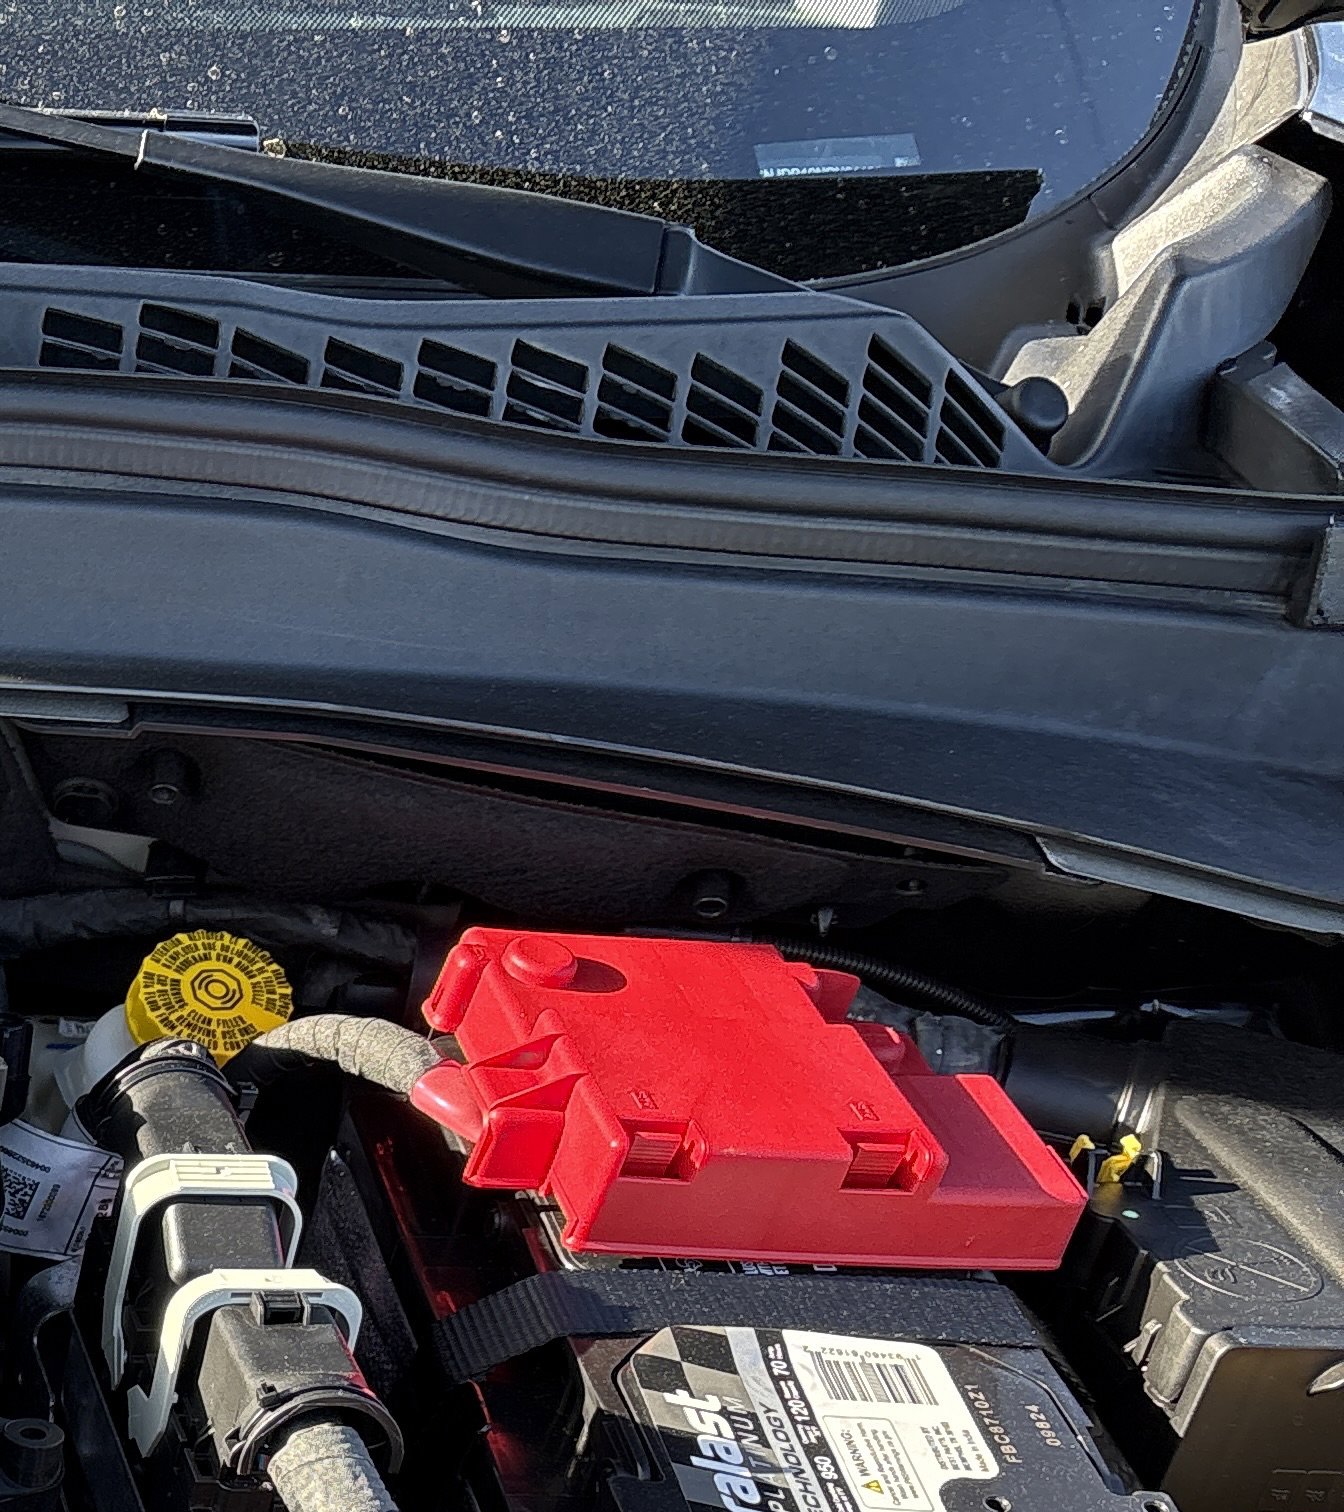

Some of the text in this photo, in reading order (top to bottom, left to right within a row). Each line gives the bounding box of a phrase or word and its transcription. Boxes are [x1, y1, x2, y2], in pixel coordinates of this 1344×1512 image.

[187, 1009, 213, 1027] CLEAN
[217, 1015, 247, 1028] FILLER
[771, 1361, 790, 1376] 70
[788, 1400, 810, 1421] 120
[814, 1456, 838, 1480] 950
